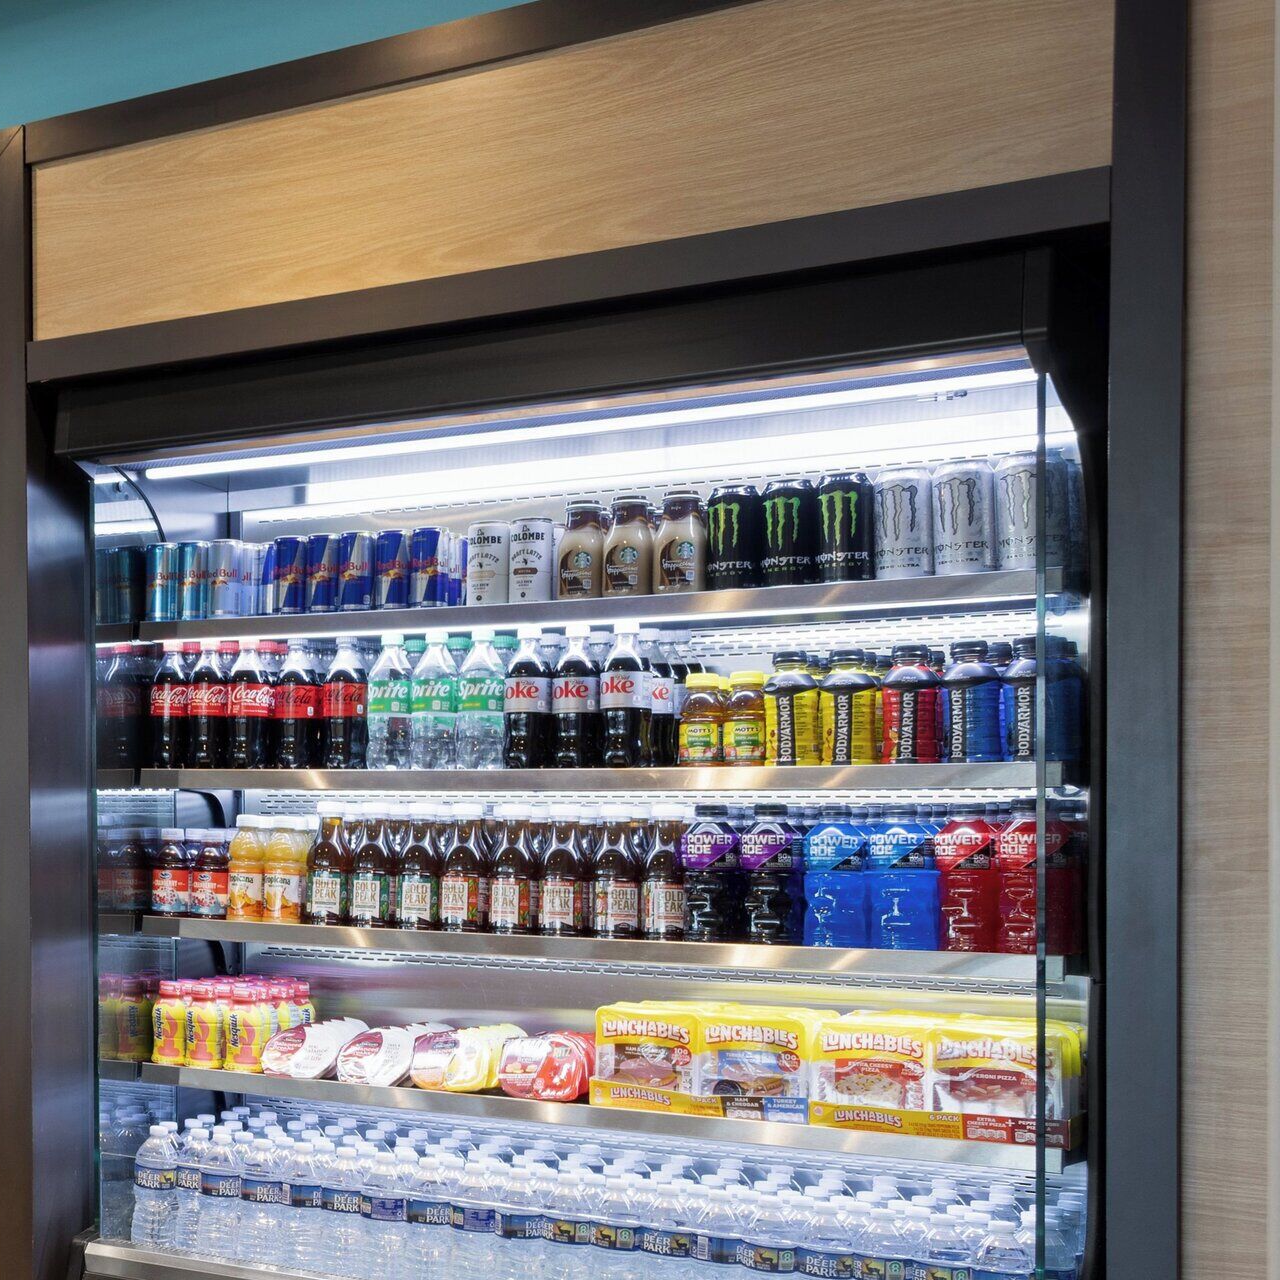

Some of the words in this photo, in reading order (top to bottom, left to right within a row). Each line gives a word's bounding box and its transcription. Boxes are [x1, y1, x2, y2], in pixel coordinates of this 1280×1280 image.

[511, 532, 545, 542] COLOMBE
[349, 562, 369, 571] Bull
[219, 568, 238, 578] Bull
[412, 680, 450, 699] prite
[459, 678, 504, 699] Sprite
[504, 681, 540, 699] oke
[552, 681, 589, 699] oke
[600, 675, 635, 695] oke
[900, 691, 915, 759] BODYARMOR
[951, 689, 963, 758] BODYARMOR
[1017, 686, 1030, 756] BODYARMOR
[779, 695, 791, 762] BODYARMOR
[834, 694, 849, 763] BODYARMOR
[687, 834, 732, 845] POWER
[742, 834, 786, 845] POWER
[810, 836, 858, 848] POWER
[870, 834, 918, 845] POWER
[934, 834, 982, 845] POWER
[687, 844, 711, 855] ADE
[742, 845, 763, 855] ADE
[810, 846, 836, 857] ADE
[870, 844, 893, 855] ADE
[935, 845, 957, 855] ADE
[1000, 844, 1027, 855] ADE
[405, 893, 428, 905] PEAK
[611, 889, 636, 900] GOLD
[611, 900, 635, 911] PEAK
[154, 1007, 163, 1040] Nesquik
[230, 1013, 239, 1047] Nesquik
[602, 1020, 690, 1043] LUNCHABLES
[705, 1024, 799, 1050] LUNCHABLES
[821, 1033, 924, 1058] LUNCHABLES
[610, 1087, 672, 1106] LUNCHABLES
[834, 1110, 902, 1128] LUNCHABLES
[935, 1114, 960, 1122] PACK
[138, 1171, 160, 1181] DEER
[137, 1178, 160, 1188] PARK
[178, 1180, 198, 1188] PARK
[257, 1186, 280, 1194] DEER
[256, 1193, 279, 1202] PARK
[334, 1195, 358, 1203] DEER
[334, 1203, 359, 1212] PARK
[643, 1232, 671, 1245] DEER
[643, 1242, 671, 1254] PARK
[806, 1255, 837, 1268] DEER
[806, 1264, 838, 1277] PARK
